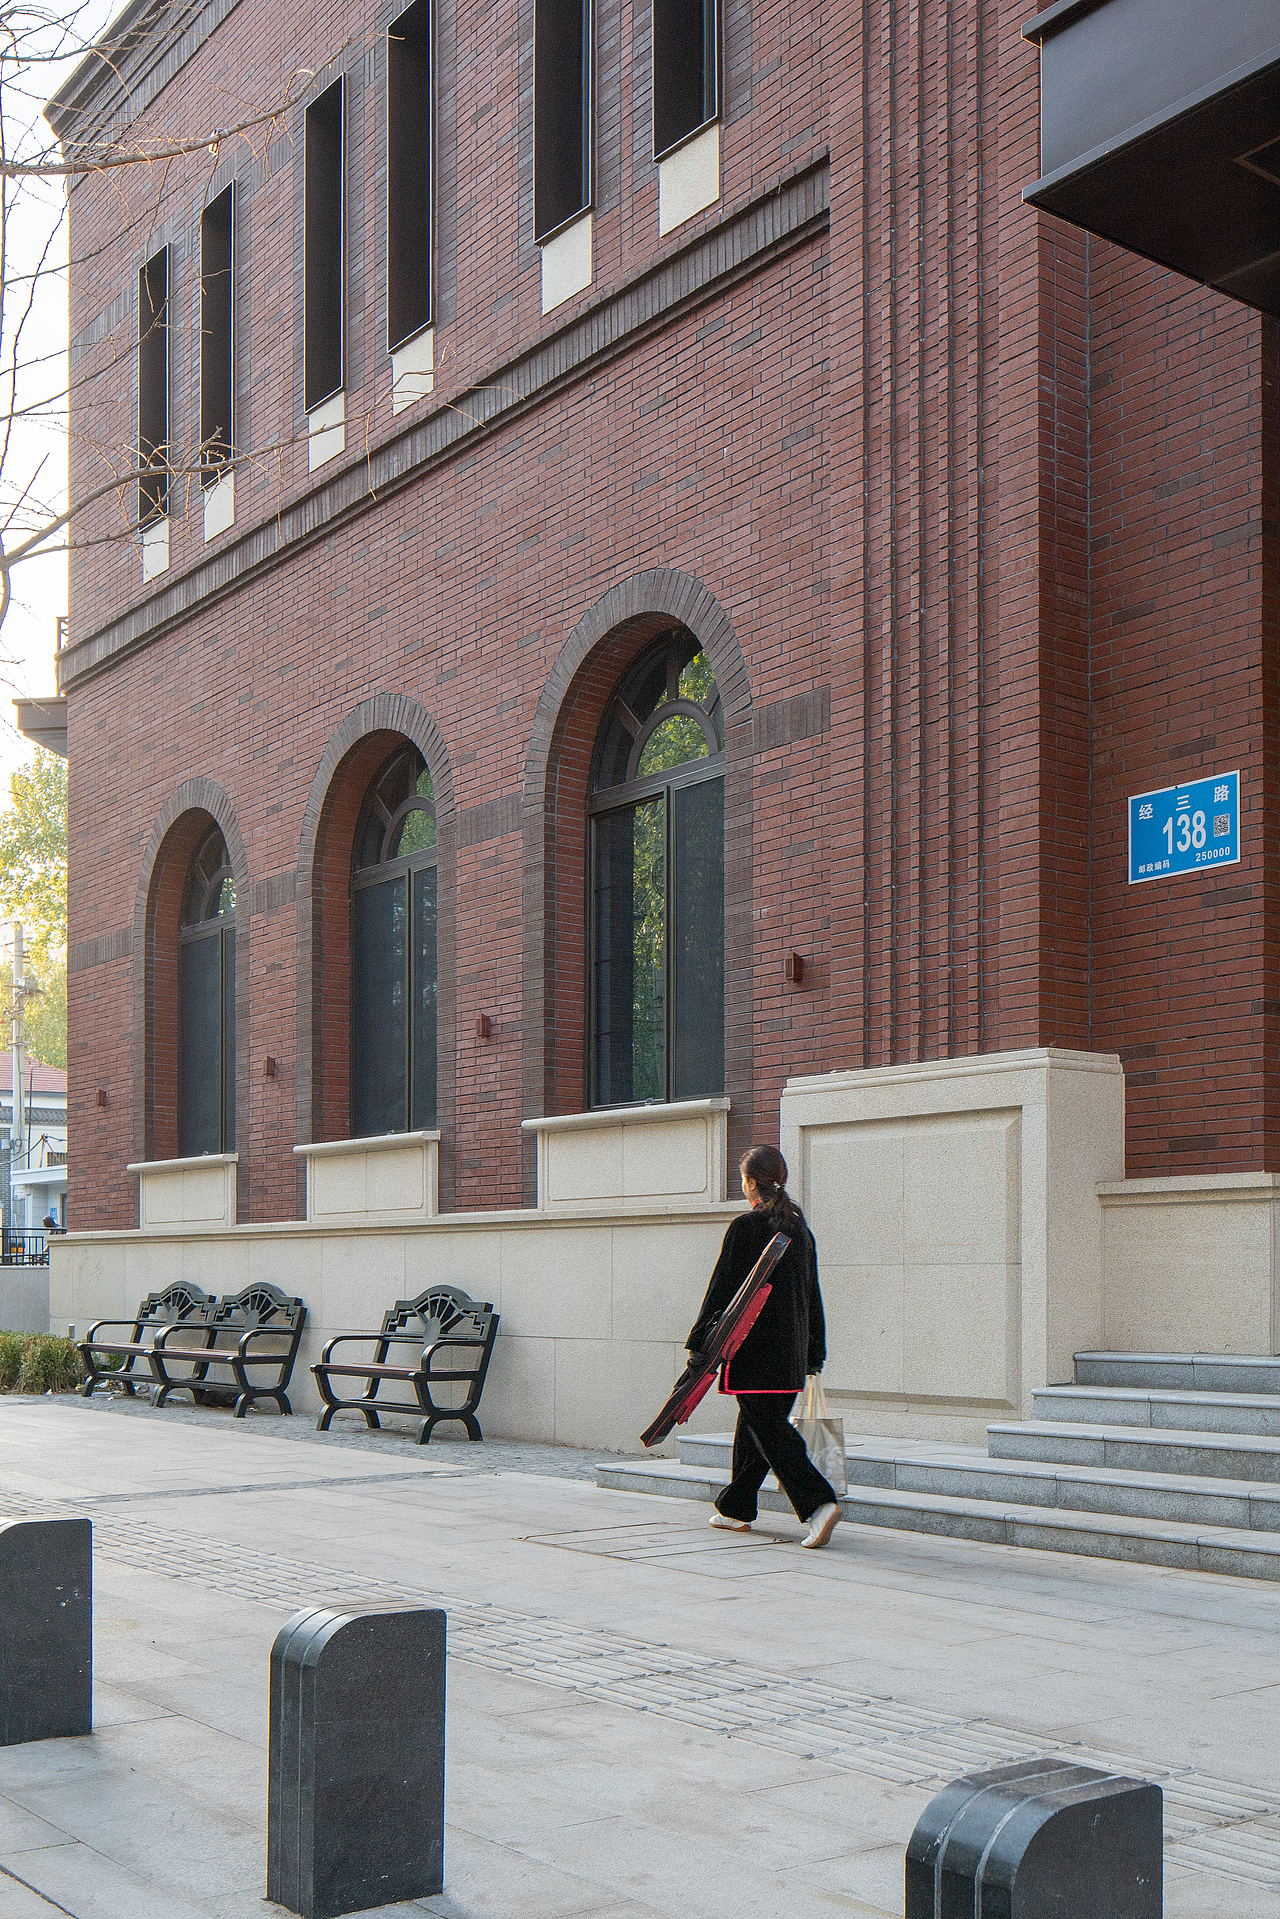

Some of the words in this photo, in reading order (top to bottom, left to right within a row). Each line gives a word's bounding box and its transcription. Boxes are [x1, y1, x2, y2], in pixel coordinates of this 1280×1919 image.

[1138, 784, 1230, 820] 经三路
[1162, 810, 1206, 855] 138
[1138, 859, 1170, 874] 邮政编码
[1195, 846, 1230, 862] 250000
